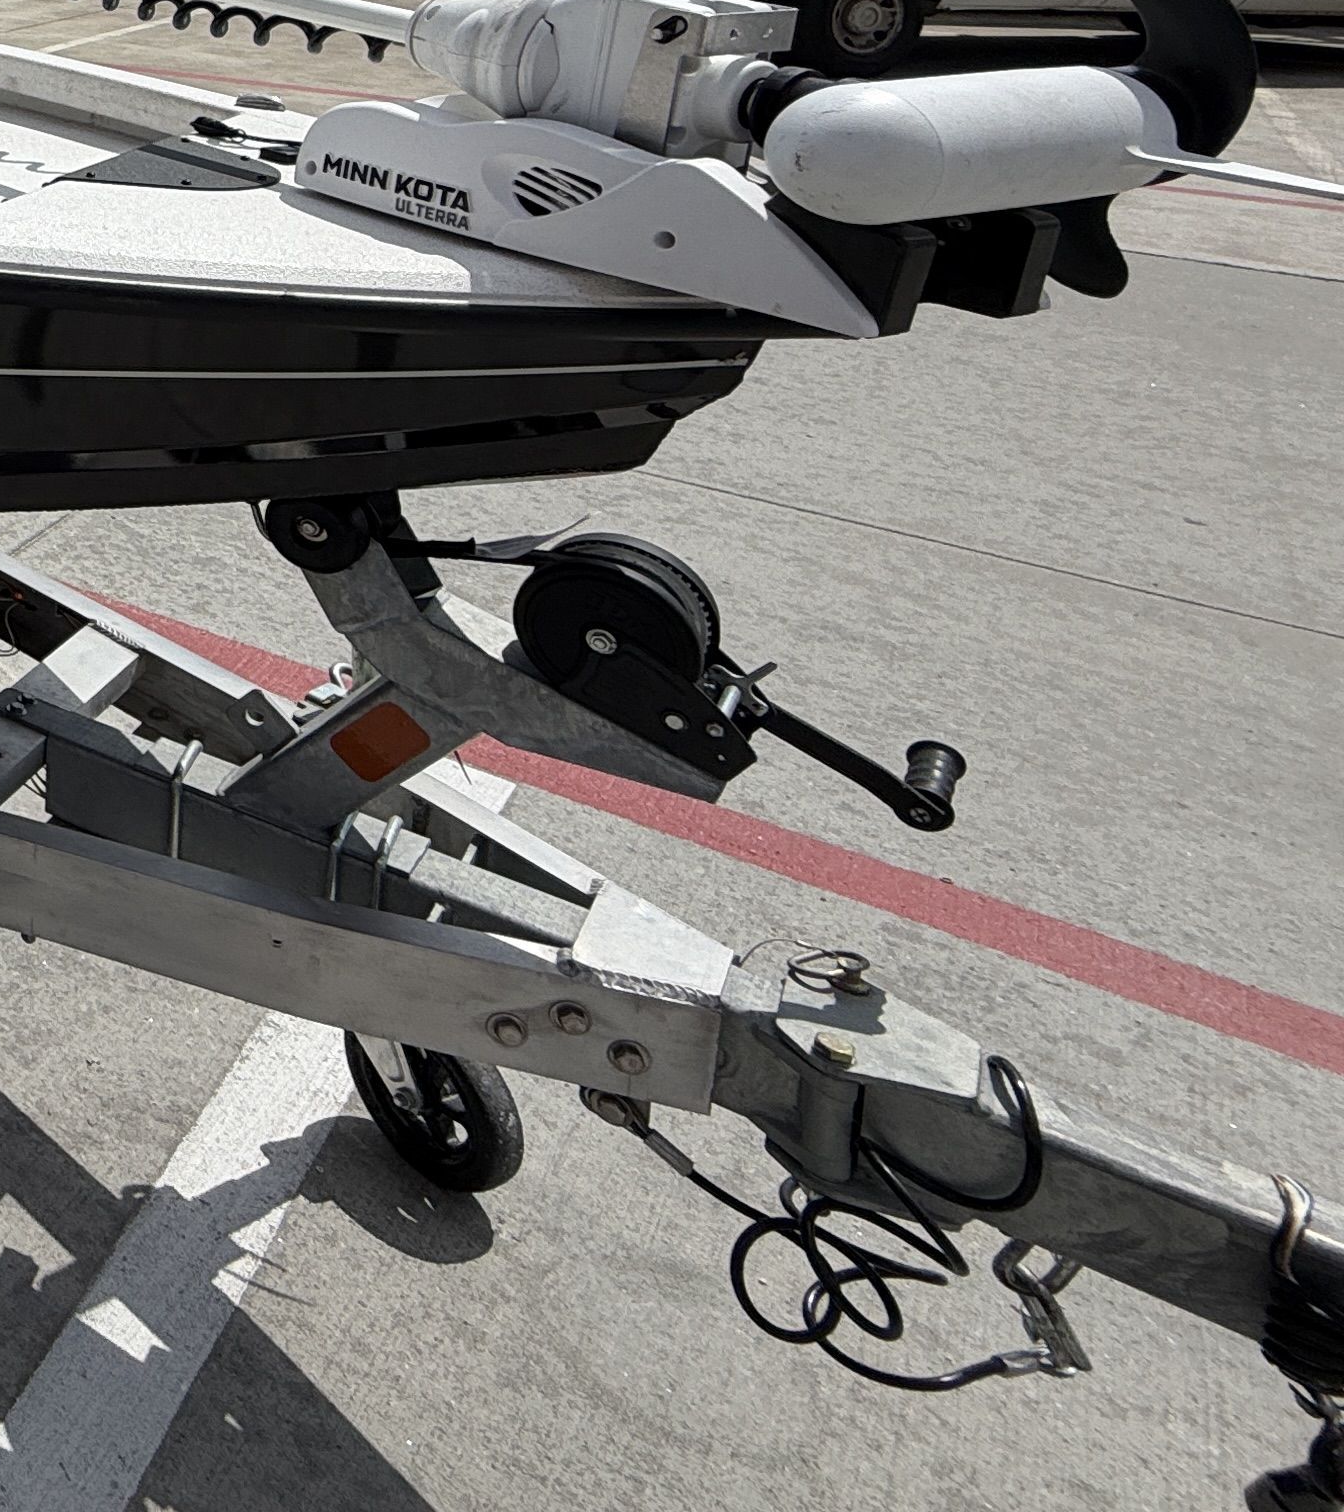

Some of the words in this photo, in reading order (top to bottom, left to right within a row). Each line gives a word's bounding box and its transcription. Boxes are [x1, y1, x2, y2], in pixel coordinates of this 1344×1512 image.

[322, 152, 389, 190] MINN
[394, 173, 470, 213] KOTA
[395, 197, 470, 231] ULTERRA
